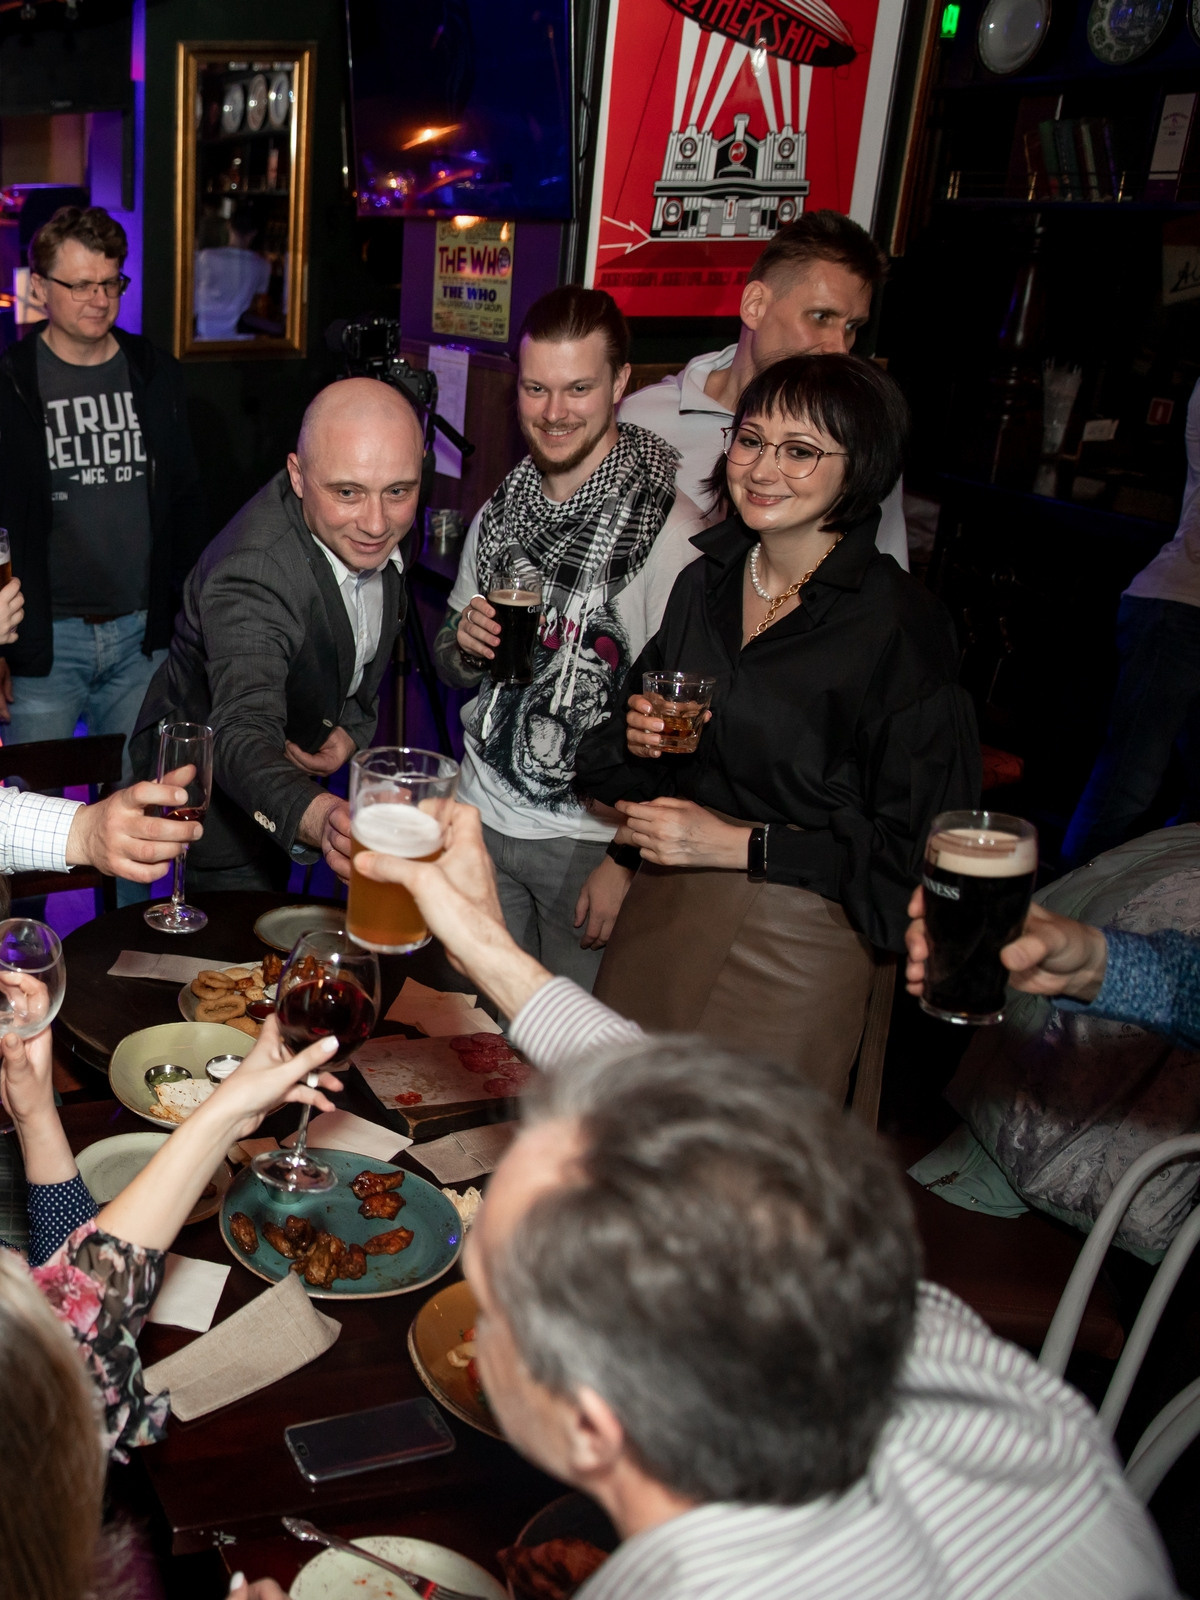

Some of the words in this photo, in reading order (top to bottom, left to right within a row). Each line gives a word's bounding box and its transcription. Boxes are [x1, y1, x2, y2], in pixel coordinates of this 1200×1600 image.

[439, 247, 467, 274] THE
[470, 246, 511, 276] WHO
[443, 287, 463, 298] THE
[467, 287, 497, 302] WHO
[47, 391, 142, 436] TRUE
[81, 467, 108, 485] MFG.
